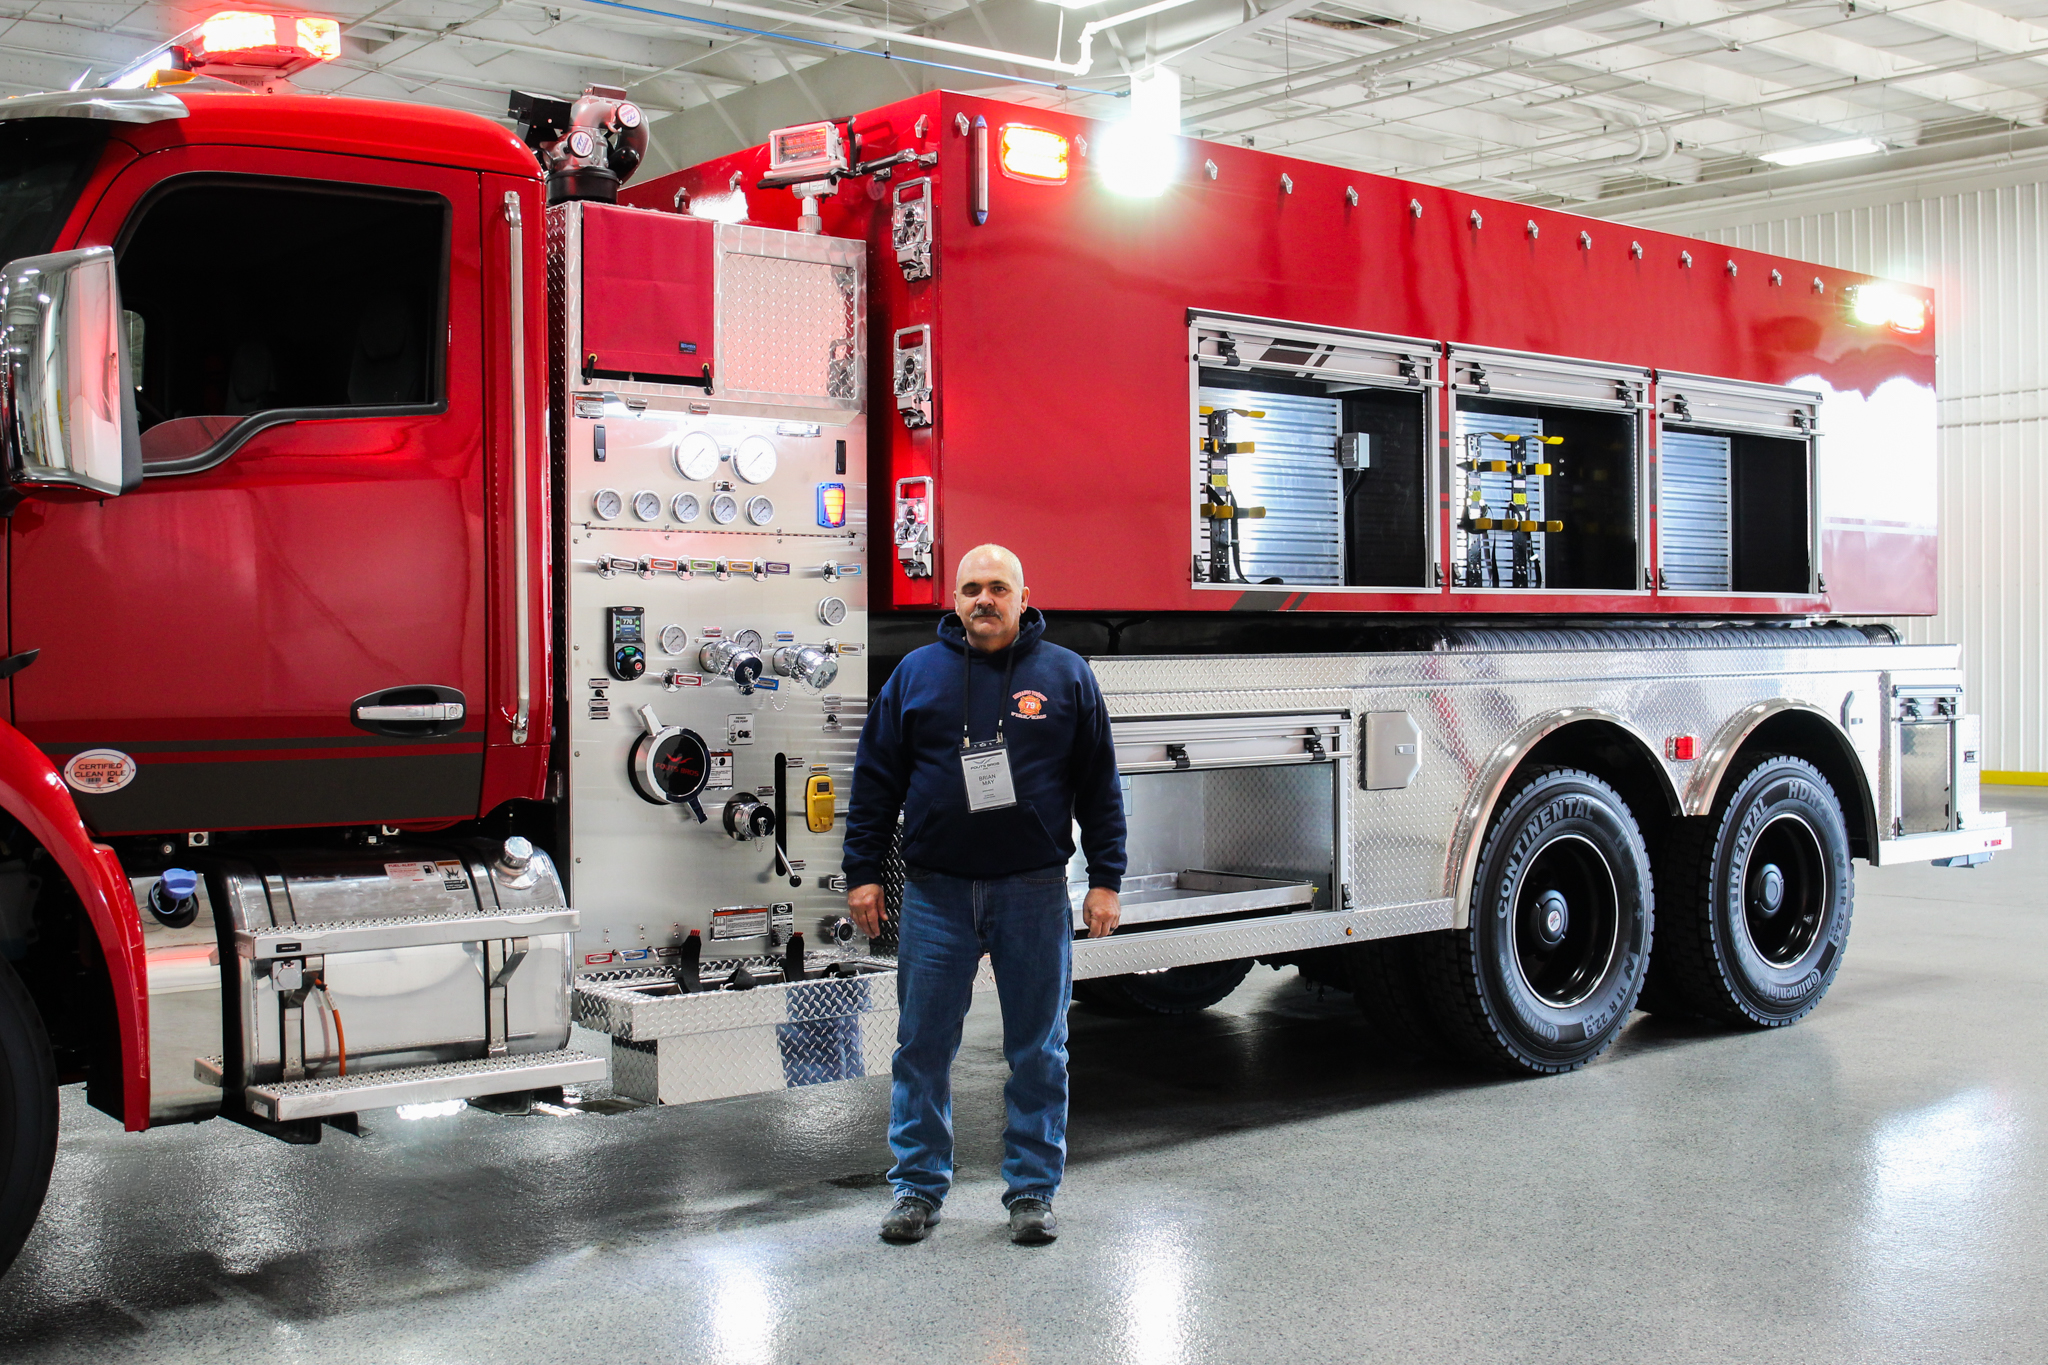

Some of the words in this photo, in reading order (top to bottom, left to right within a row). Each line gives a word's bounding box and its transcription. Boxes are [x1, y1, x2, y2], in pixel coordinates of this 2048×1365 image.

[1025, 701, 1036, 710] 79
[655, 762, 679, 773] FOUTS
[680, 767, 700, 777] BROS
[978, 773, 997, 781] BRIAN
[1496, 797, 1594, 919] CONTINENTAL
[1728, 797, 1768, 964] CONTINENTAL
[1833, 912, 1845, 943] 22.5
[1616, 986, 1627, 1001] 11
[1766, 968, 1821, 1000] Continental
[1502, 968, 1560, 1046] Continental
[1609, 1001, 1618, 1013] R
[1586, 1012, 1608, 1037] 22.5
